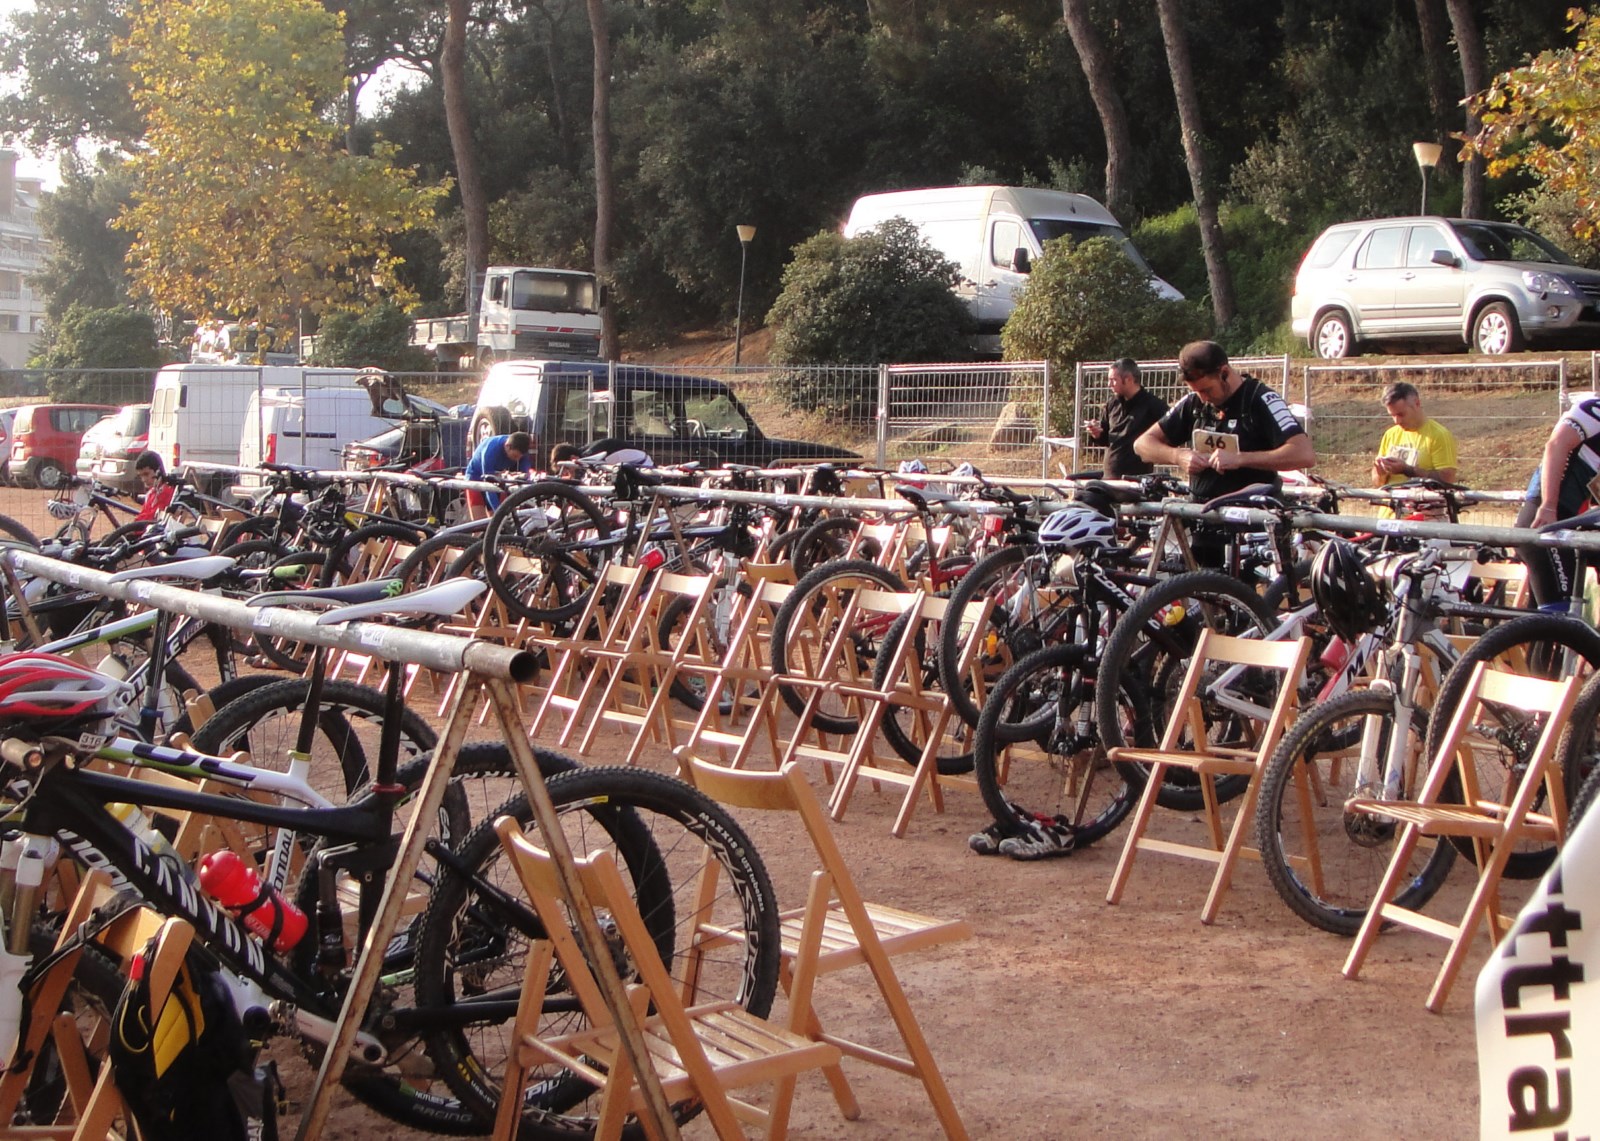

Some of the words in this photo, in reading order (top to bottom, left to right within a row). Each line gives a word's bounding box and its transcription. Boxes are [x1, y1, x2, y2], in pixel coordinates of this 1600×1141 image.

[1204, 435, 1226, 449] 46
[698, 810, 738, 850] MAXXIS
[740, 856, 753, 875] UST
[134, 836, 265, 976] CANYON
